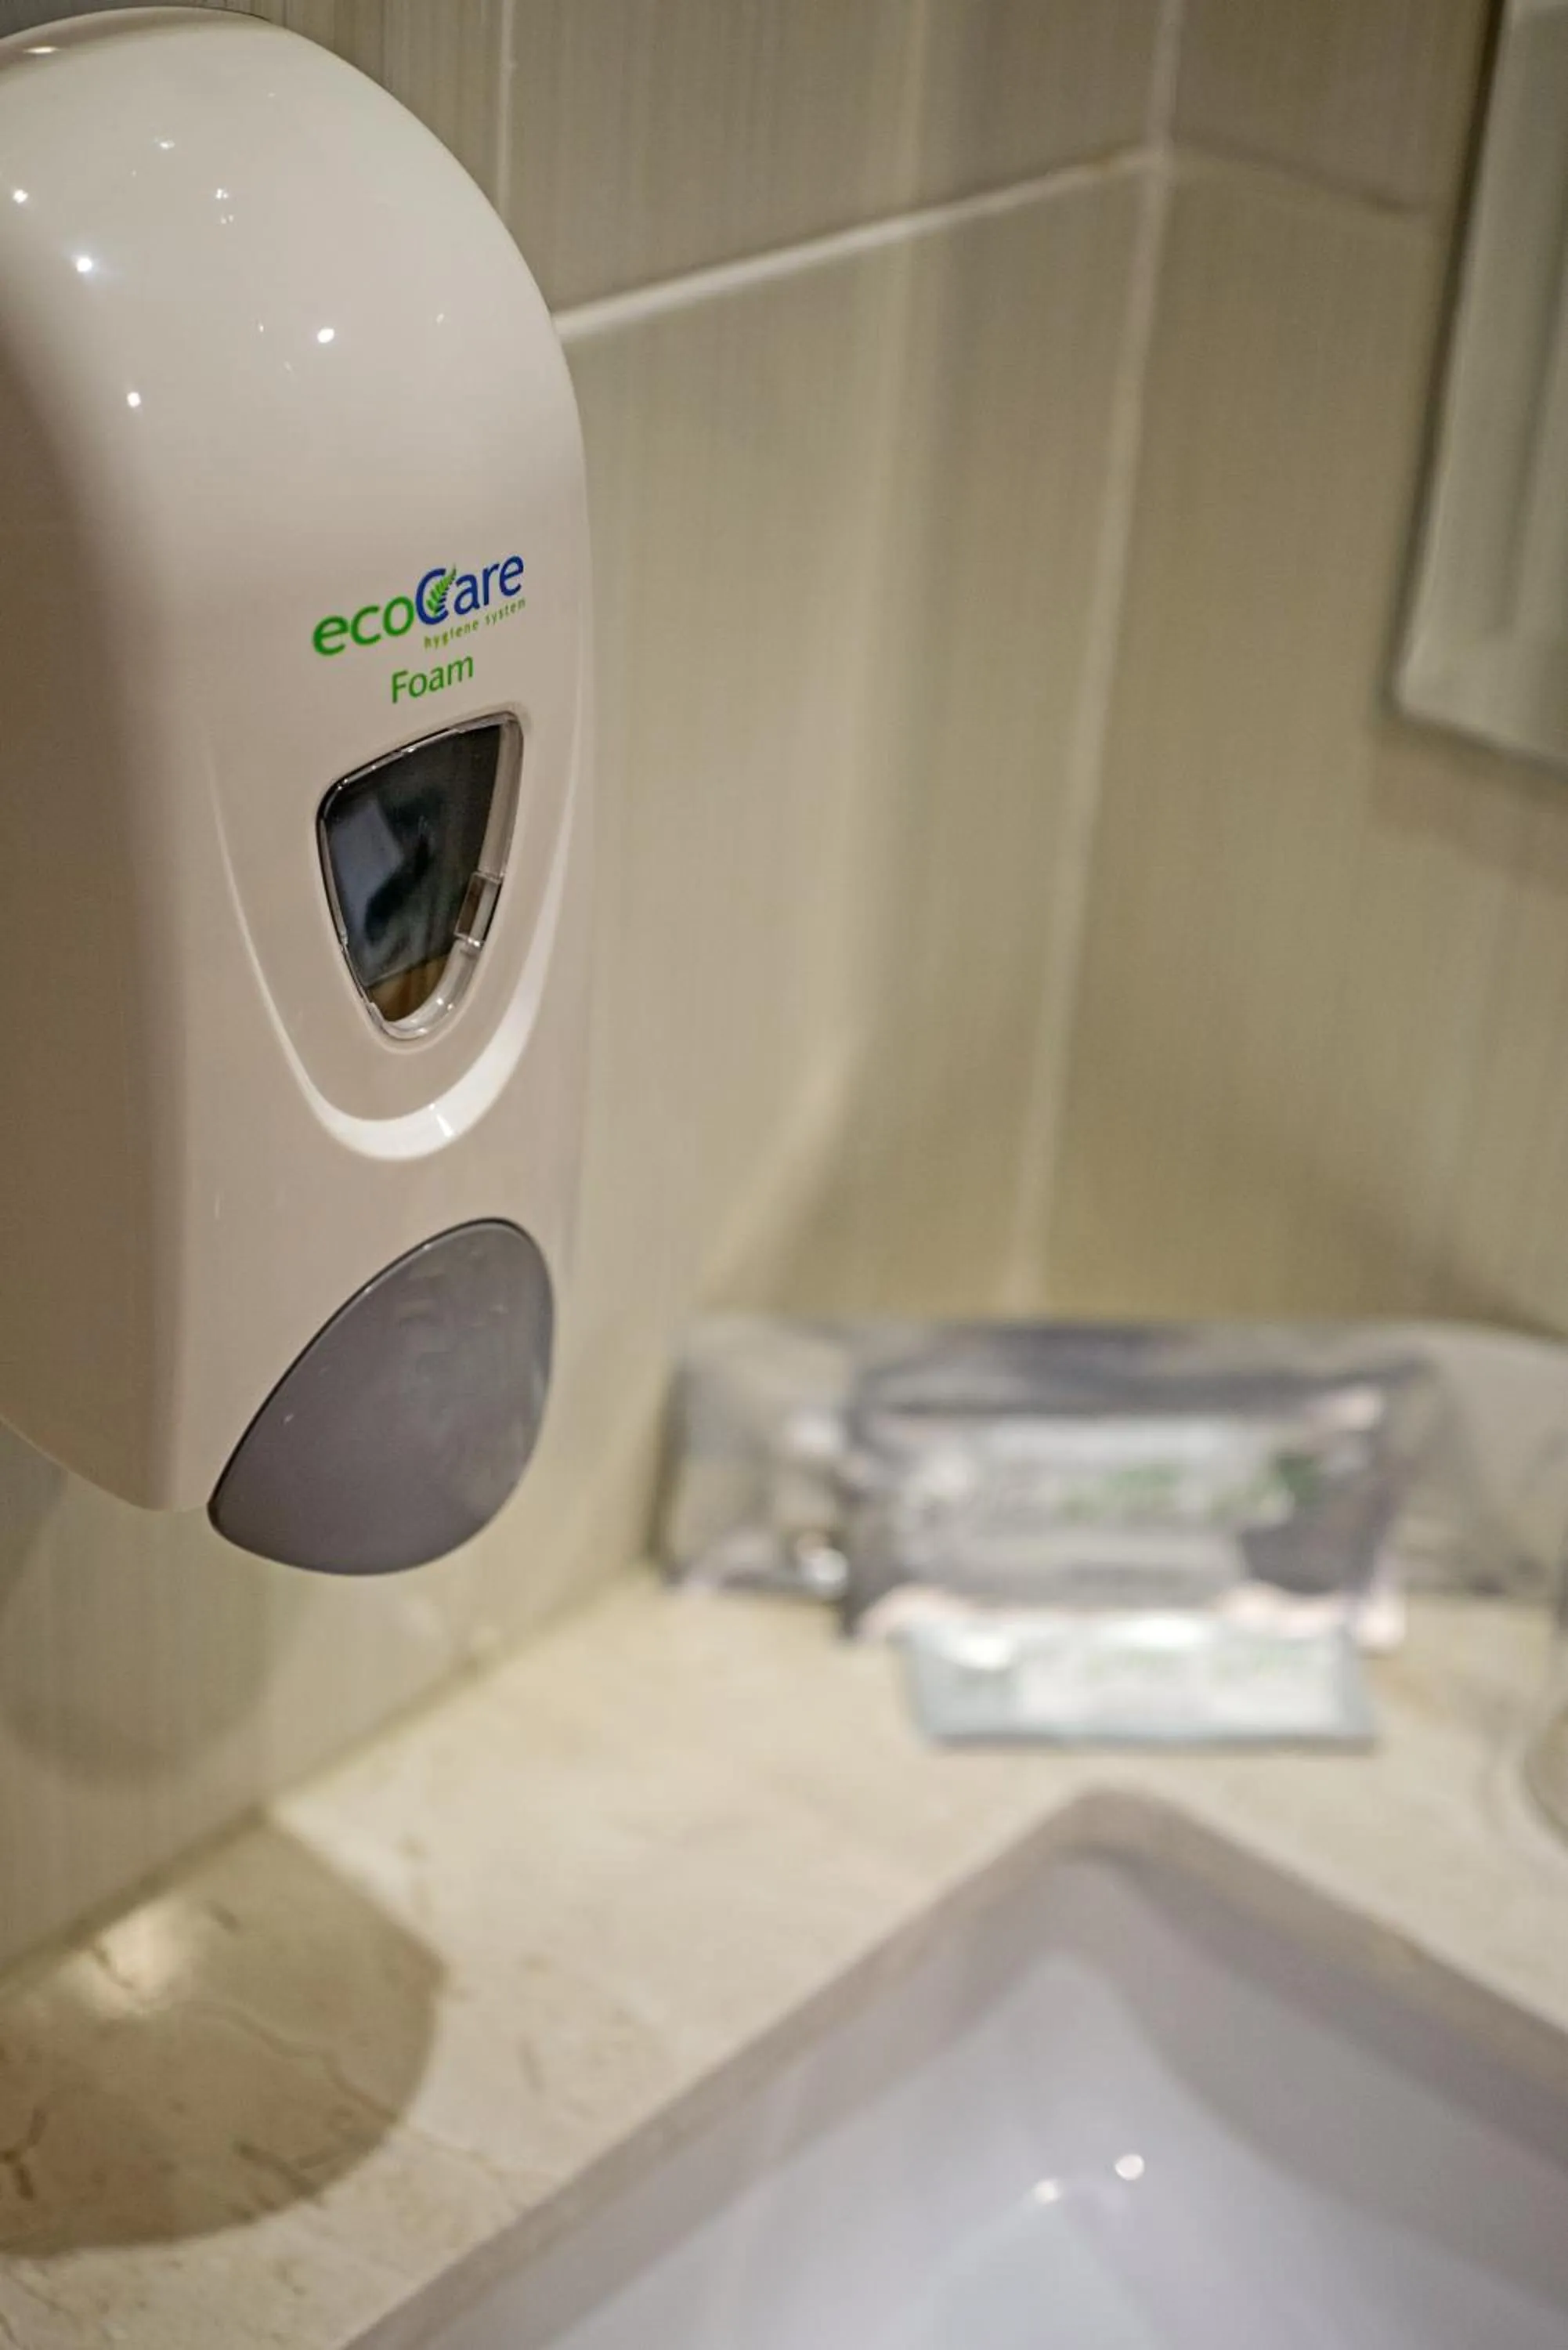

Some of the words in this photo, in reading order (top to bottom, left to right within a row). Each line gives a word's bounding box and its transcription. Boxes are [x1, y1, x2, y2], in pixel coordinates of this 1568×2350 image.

[312, 555, 524, 656] ecoCare
[424, 620, 479, 649] hygiene
[485, 598, 526, 626] system
[392, 656, 473, 703] Foam
